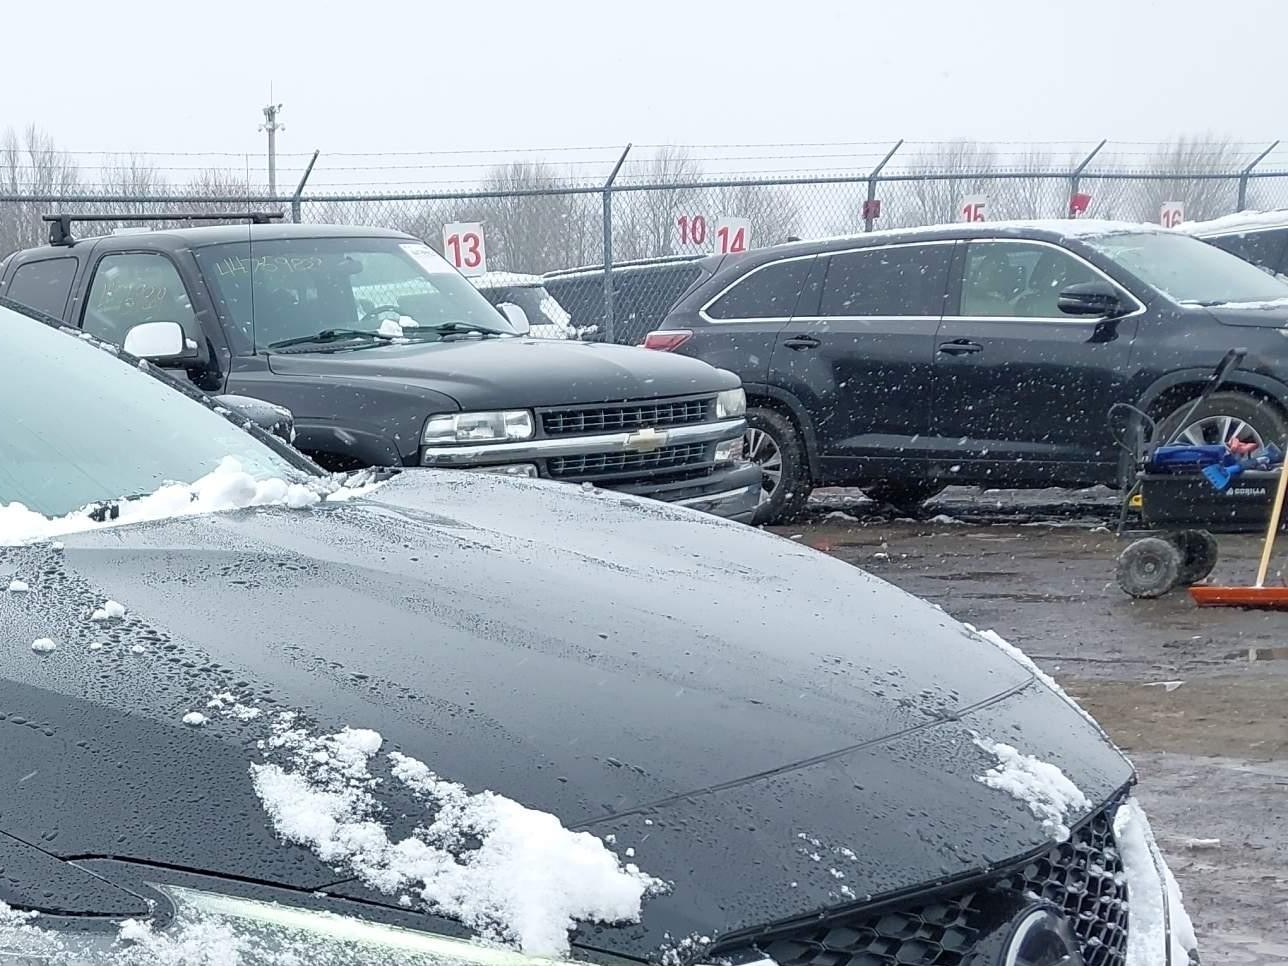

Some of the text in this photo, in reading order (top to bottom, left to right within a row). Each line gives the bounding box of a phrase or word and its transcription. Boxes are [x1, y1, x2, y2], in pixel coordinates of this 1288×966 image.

[962, 204, 985, 222] 15
[1163, 209, 1182, 228] 16
[678, 215, 706, 245] 10
[717, 226, 746, 254] 14
[447, 233, 481, 268] 13
[1234, 487, 1266, 496] GORILLA
